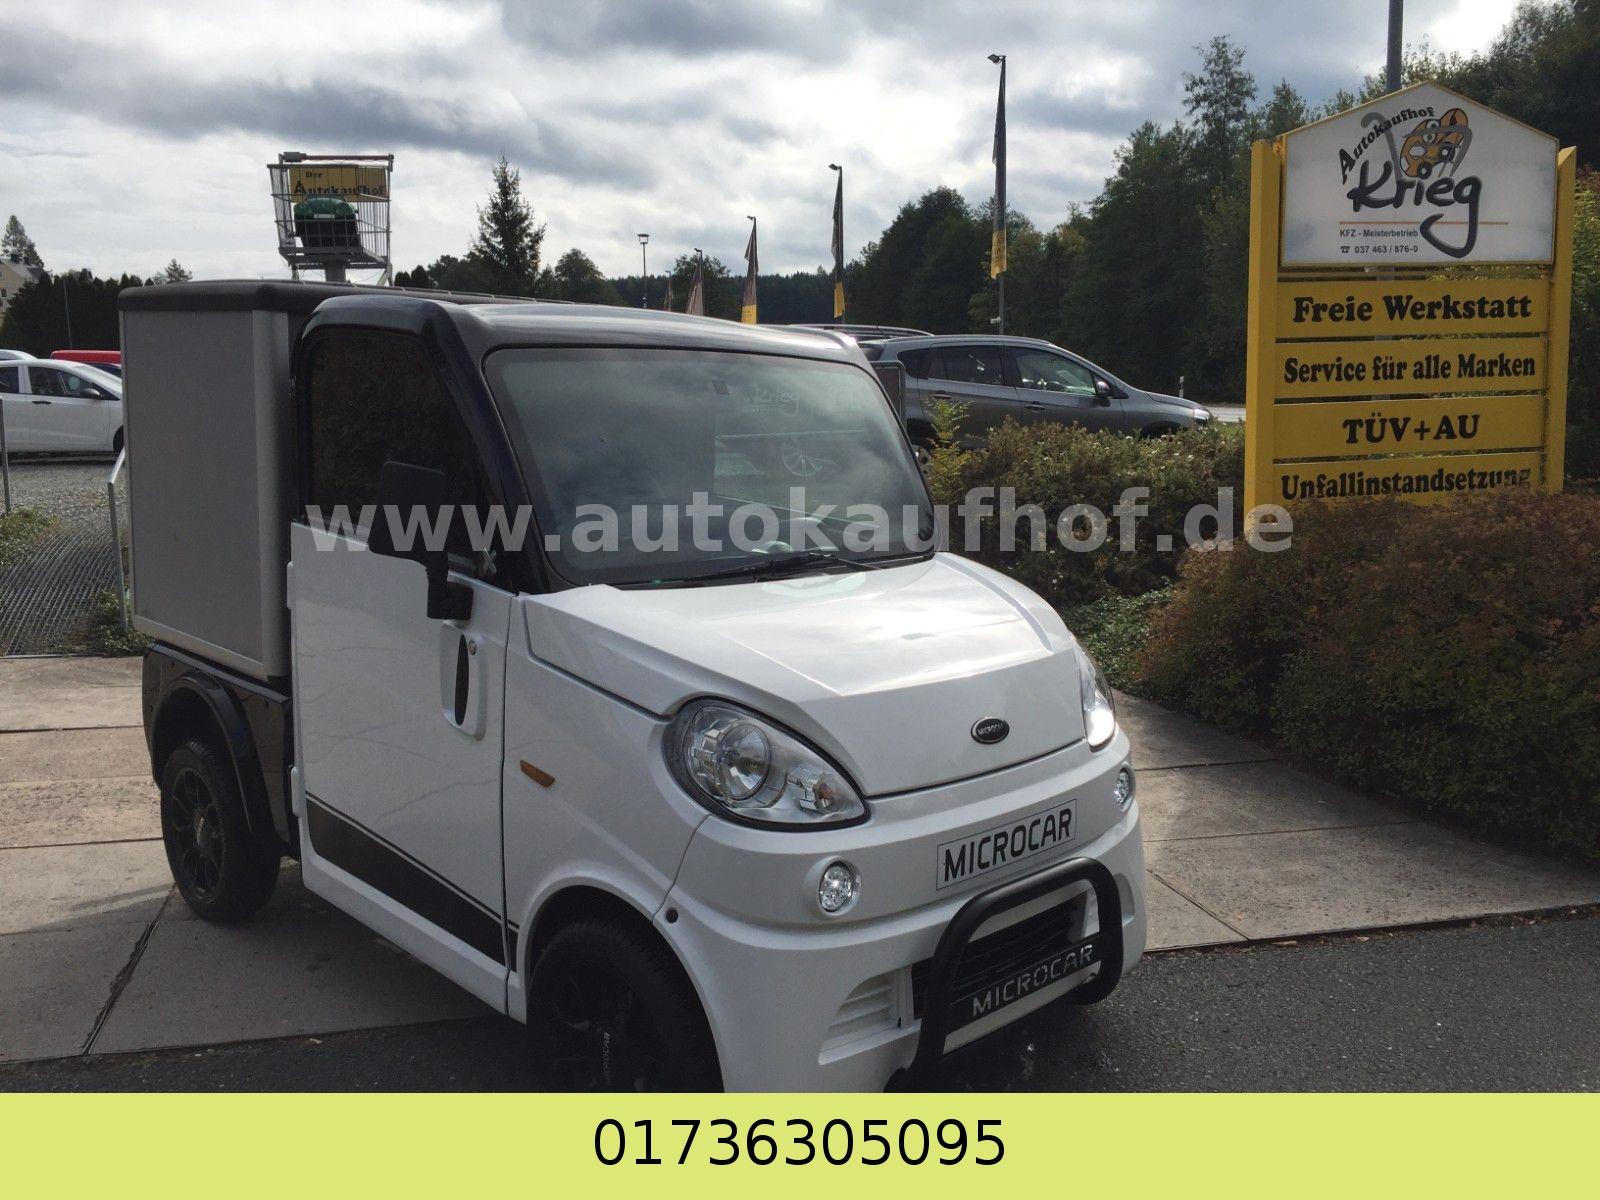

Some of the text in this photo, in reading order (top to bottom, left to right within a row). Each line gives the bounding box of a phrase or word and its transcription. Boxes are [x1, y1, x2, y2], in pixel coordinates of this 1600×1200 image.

[1338, 106, 1435, 185] Autokaufhof
[1339, 229, 1357, 238] KFZ
[1363, 229, 1419, 238] Meisterbetrieb
[1347, 160, 1483, 258] Krieg
[1354, 245, 1370, 254] 037
[1372, 245, 1387, 254] 463
[1292, 295, 1532, 323] Freie Werkstatt
[1284, 352, 1536, 384] Service für alle Marken
[944, 807, 1073, 882] MICROCAR
[972, 943, 1095, 1018] MICROCAR
